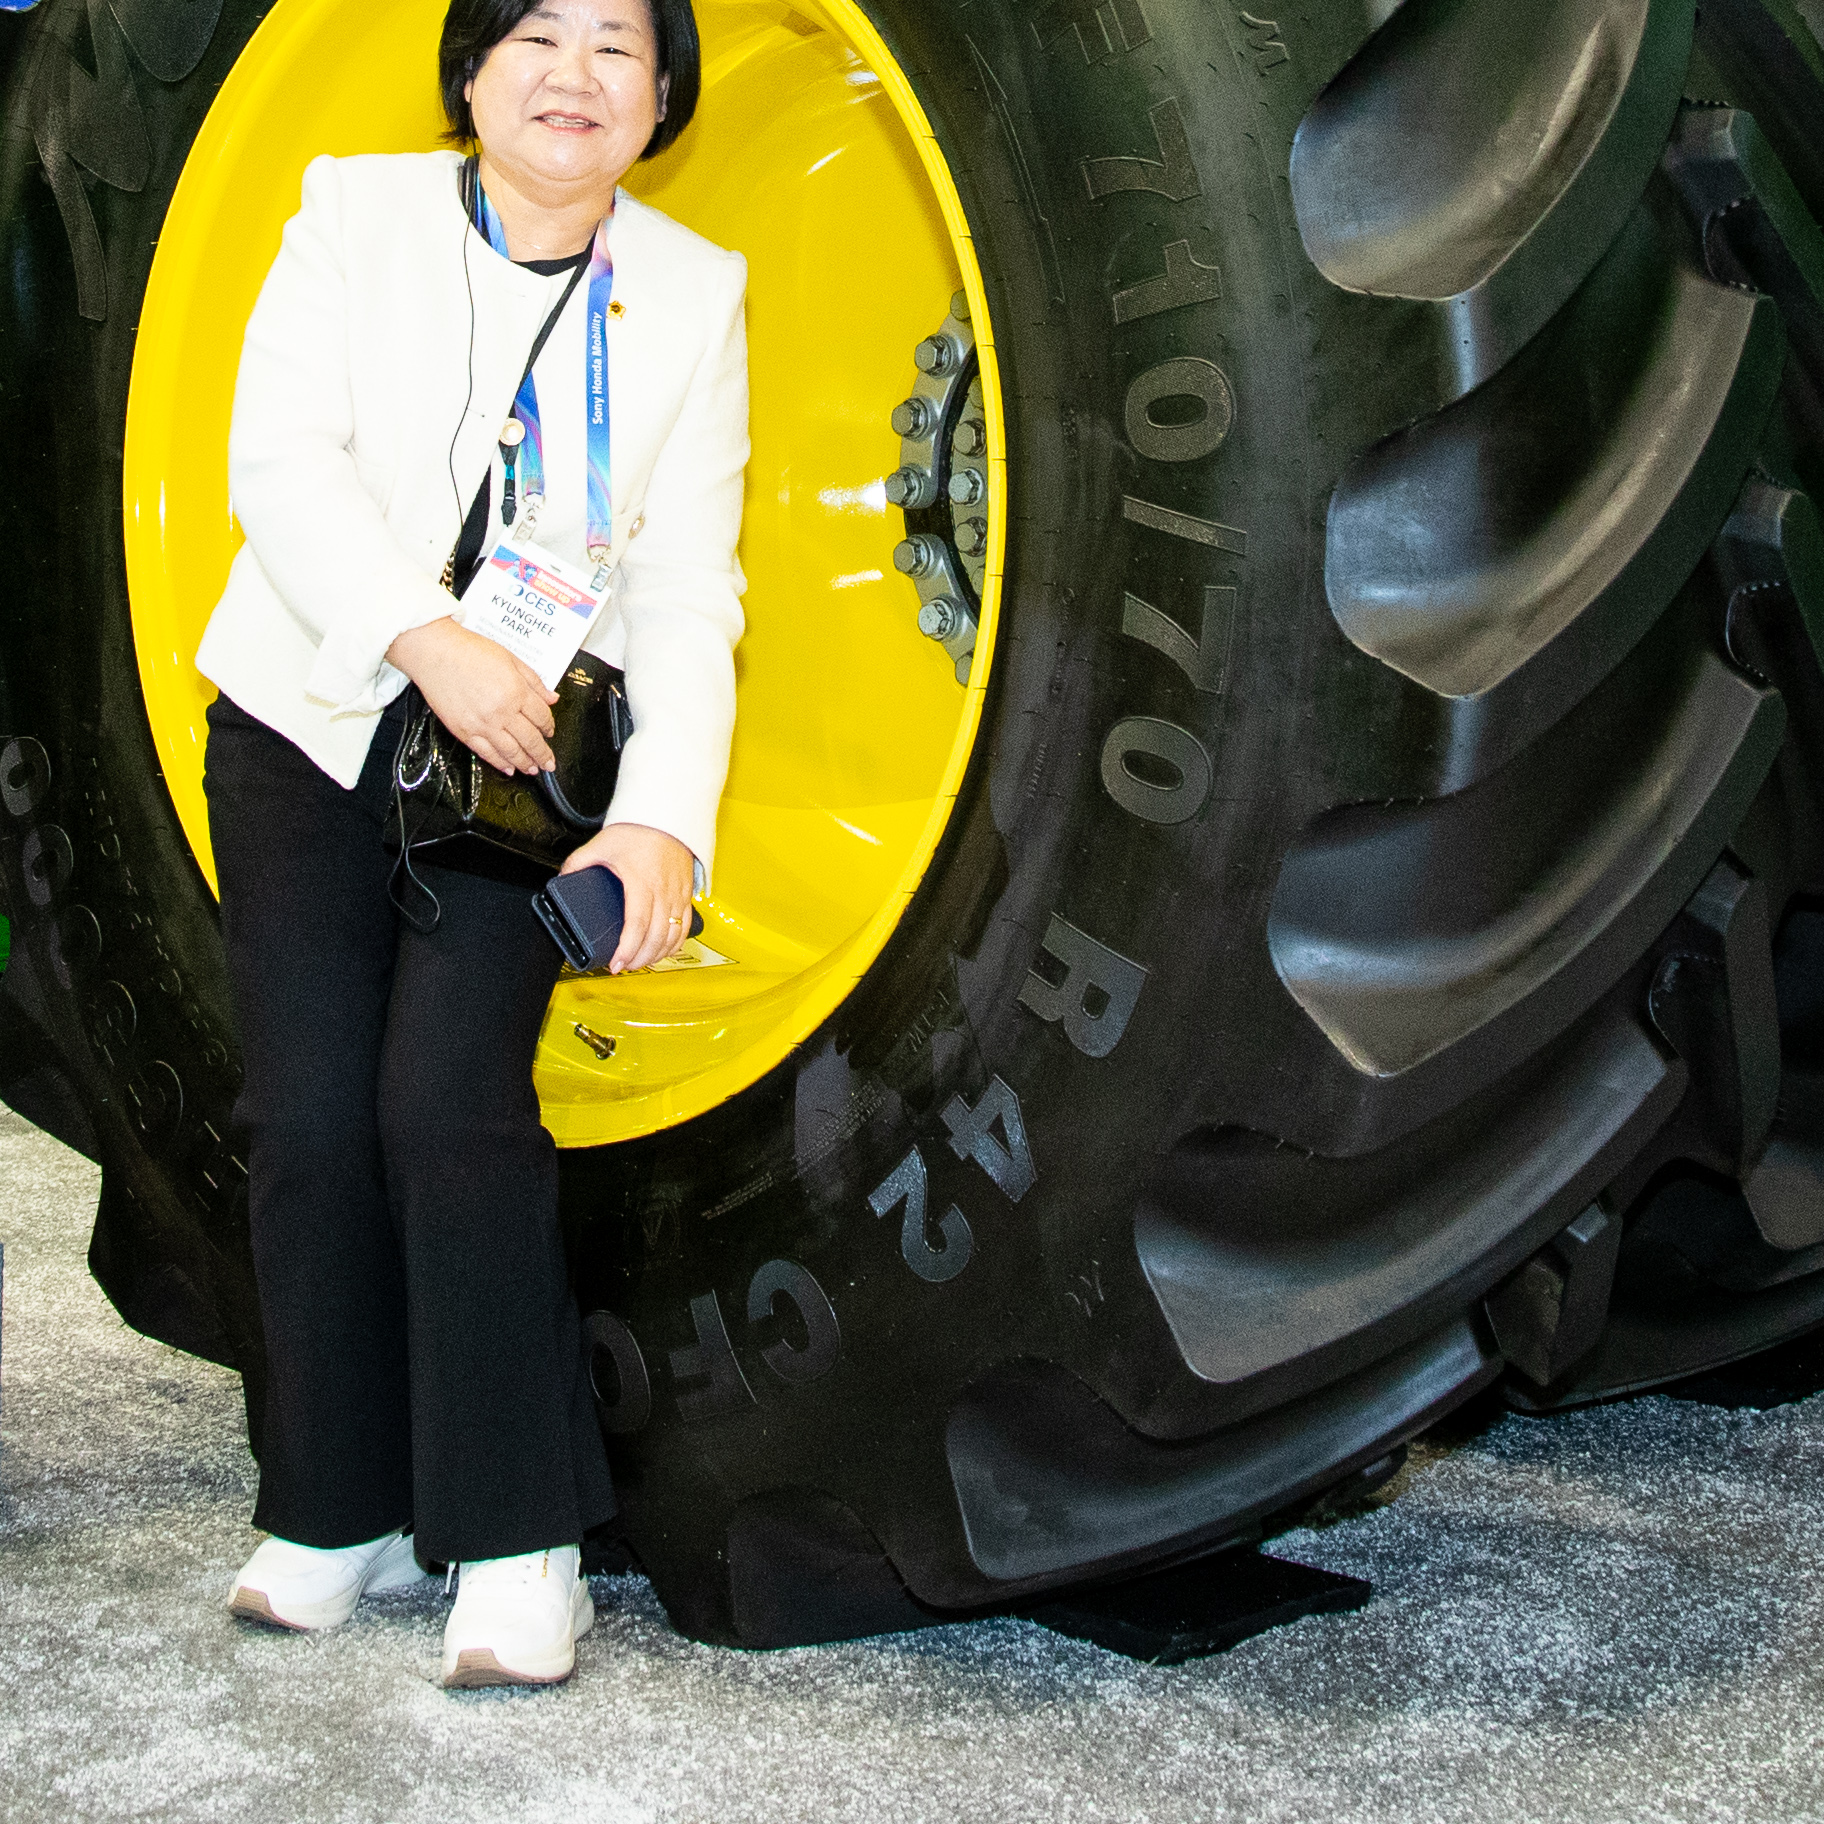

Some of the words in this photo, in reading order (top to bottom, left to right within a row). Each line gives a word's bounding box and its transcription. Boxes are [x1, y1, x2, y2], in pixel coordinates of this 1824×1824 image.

[592, 311, 602, 356] Mobility
[592, 359, 602, 394] Honda
[592, 397, 604, 424] Sony
[492, 594, 556, 638] KYUNGHEE
[525, 589, 556, 616] CES
[501, 615, 533, 639] PARK
[868, 1073, 1039, 1284] 42
